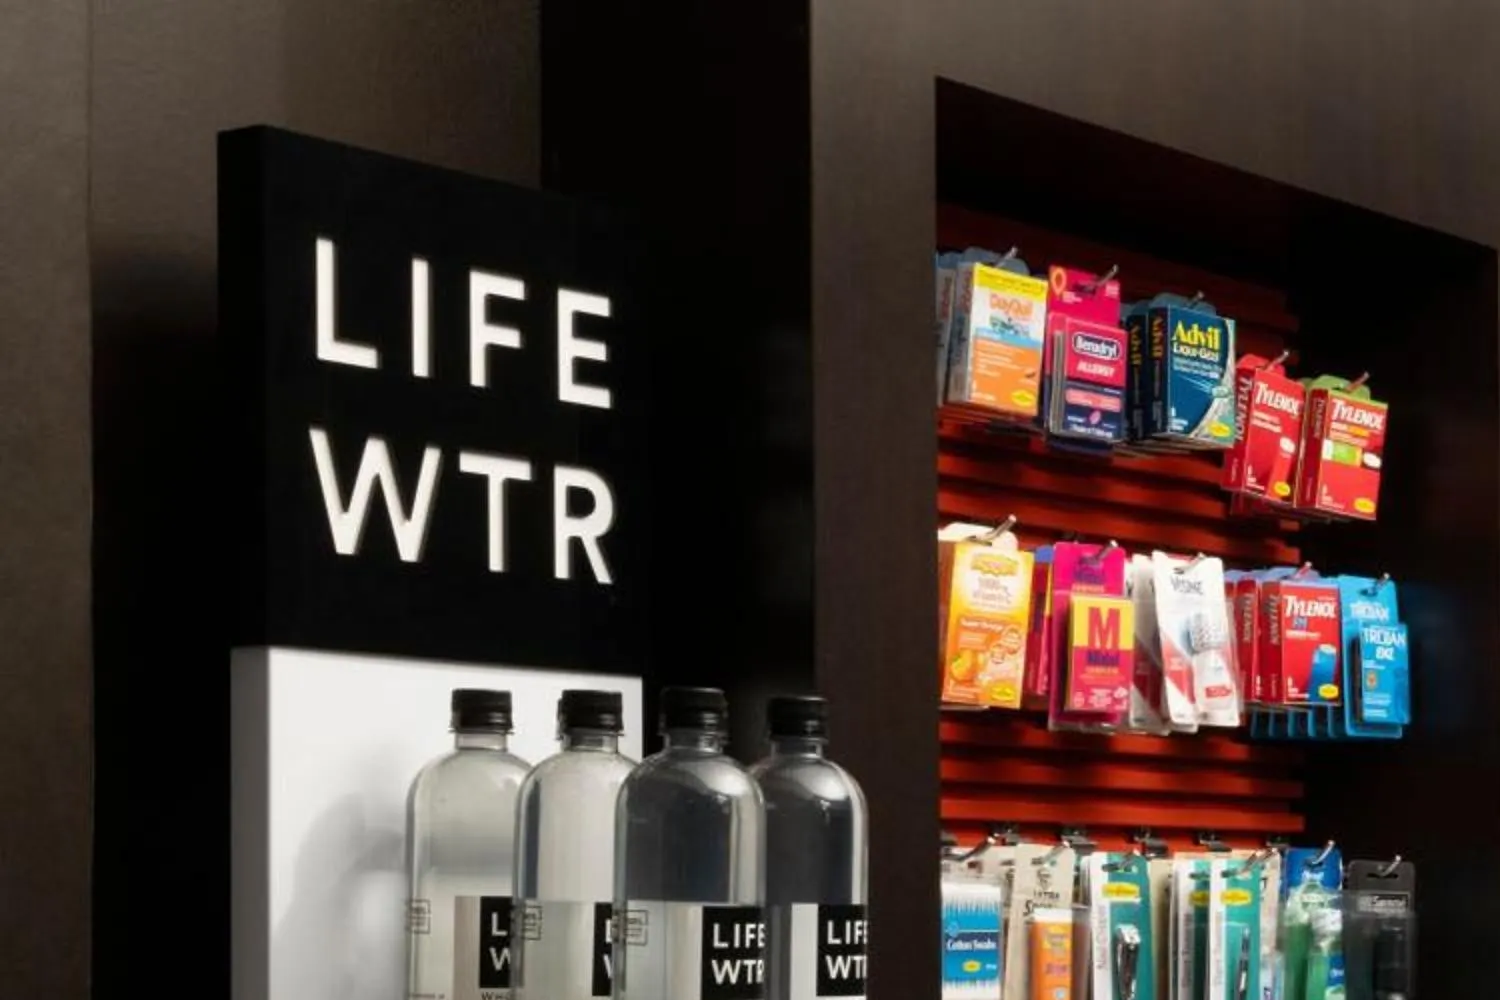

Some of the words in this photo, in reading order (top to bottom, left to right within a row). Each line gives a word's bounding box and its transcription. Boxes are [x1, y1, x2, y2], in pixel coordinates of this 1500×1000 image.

[315, 237, 613, 409] LIFE
[1172, 320, 1220, 350] Advil
[1075, 335, 1117, 359] Benadryl
[1235, 375, 1252, 440] TYLENOL
[1255, 382, 1300, 419] TYLENOL
[1332, 398, 1385, 430] TYLENOL
[309, 426, 616, 585] WTR
[1283, 595, 1336, 618] TYLENOL
[1088, 607, 1120, 650] M
[1362, 627, 1406, 648] TROJAN
[947, 938, 972, 951] Cotton
[973, 938, 997, 951] Swabs
[825, 955, 867, 980] WT
